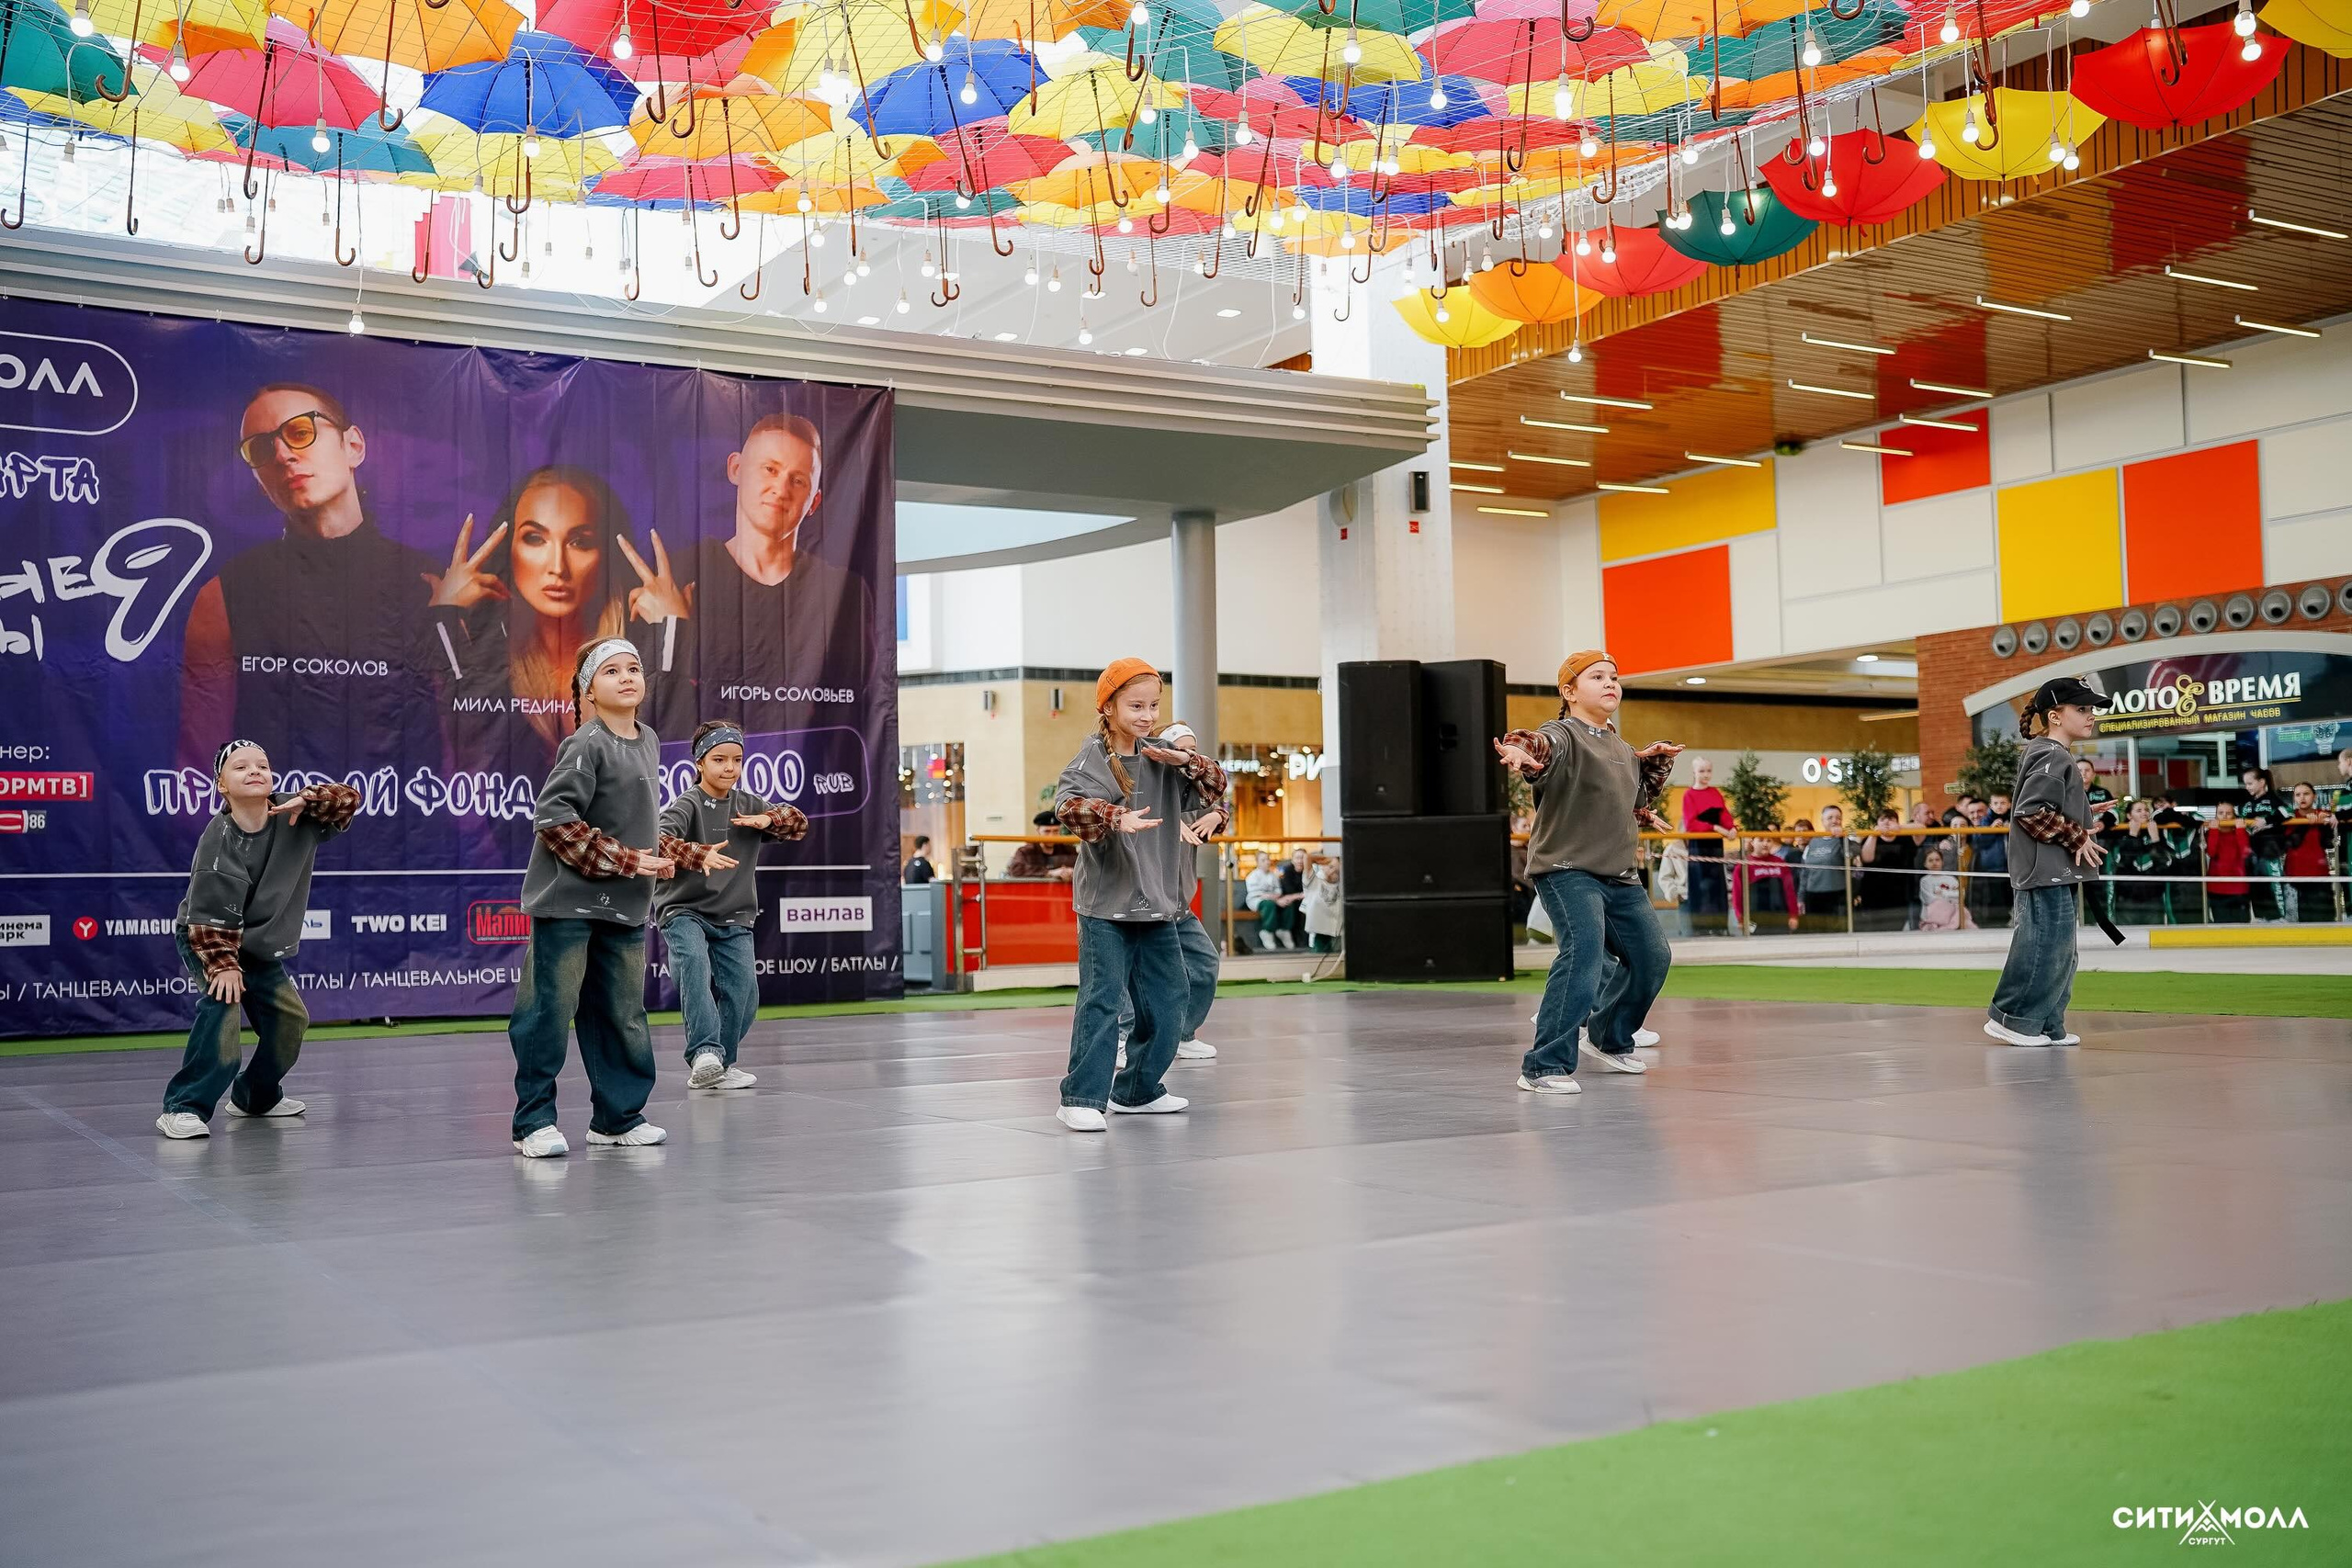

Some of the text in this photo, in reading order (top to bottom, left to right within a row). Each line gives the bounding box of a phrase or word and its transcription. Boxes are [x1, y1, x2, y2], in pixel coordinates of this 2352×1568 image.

[0, 451, 99, 504] РТА
[243, 656, 388, 676] ЕГОР СОКОЛОВ
[720, 684, 854, 703] ИГОРЬ СОЛОВЬЕВ
[2092, 685, 2179, 716] ЛОТО
[2208, 672, 2301, 705] ВРЕМЯ
[453, 697, 576, 715] МИЛА РЕДИНА
[2099, 707, 2281, 733] СПЕЦИАЛИЗИРОВАННЫЙ МАГАЗИН ЧАСОВ
[0, 746, 50, 763] нер:
[404, 765, 536, 820] ФОНД
[814, 773, 854, 795] RUB
[29, 814, 46, 829] 86
[351, 914, 447, 933] TWO KEI
[786, 907, 865, 922] ванлав
[33, 976, 198, 999] ТАНЦЕВАЛЬНОЕ
[288, 973, 343, 990] АТТЛЫ
[362, 967, 506, 988] ТАНЦЕВАЛЬНОЕ
[778, 957, 818, 975] ШОУ
[831, 955, 887, 973] БАТТЛЫ
